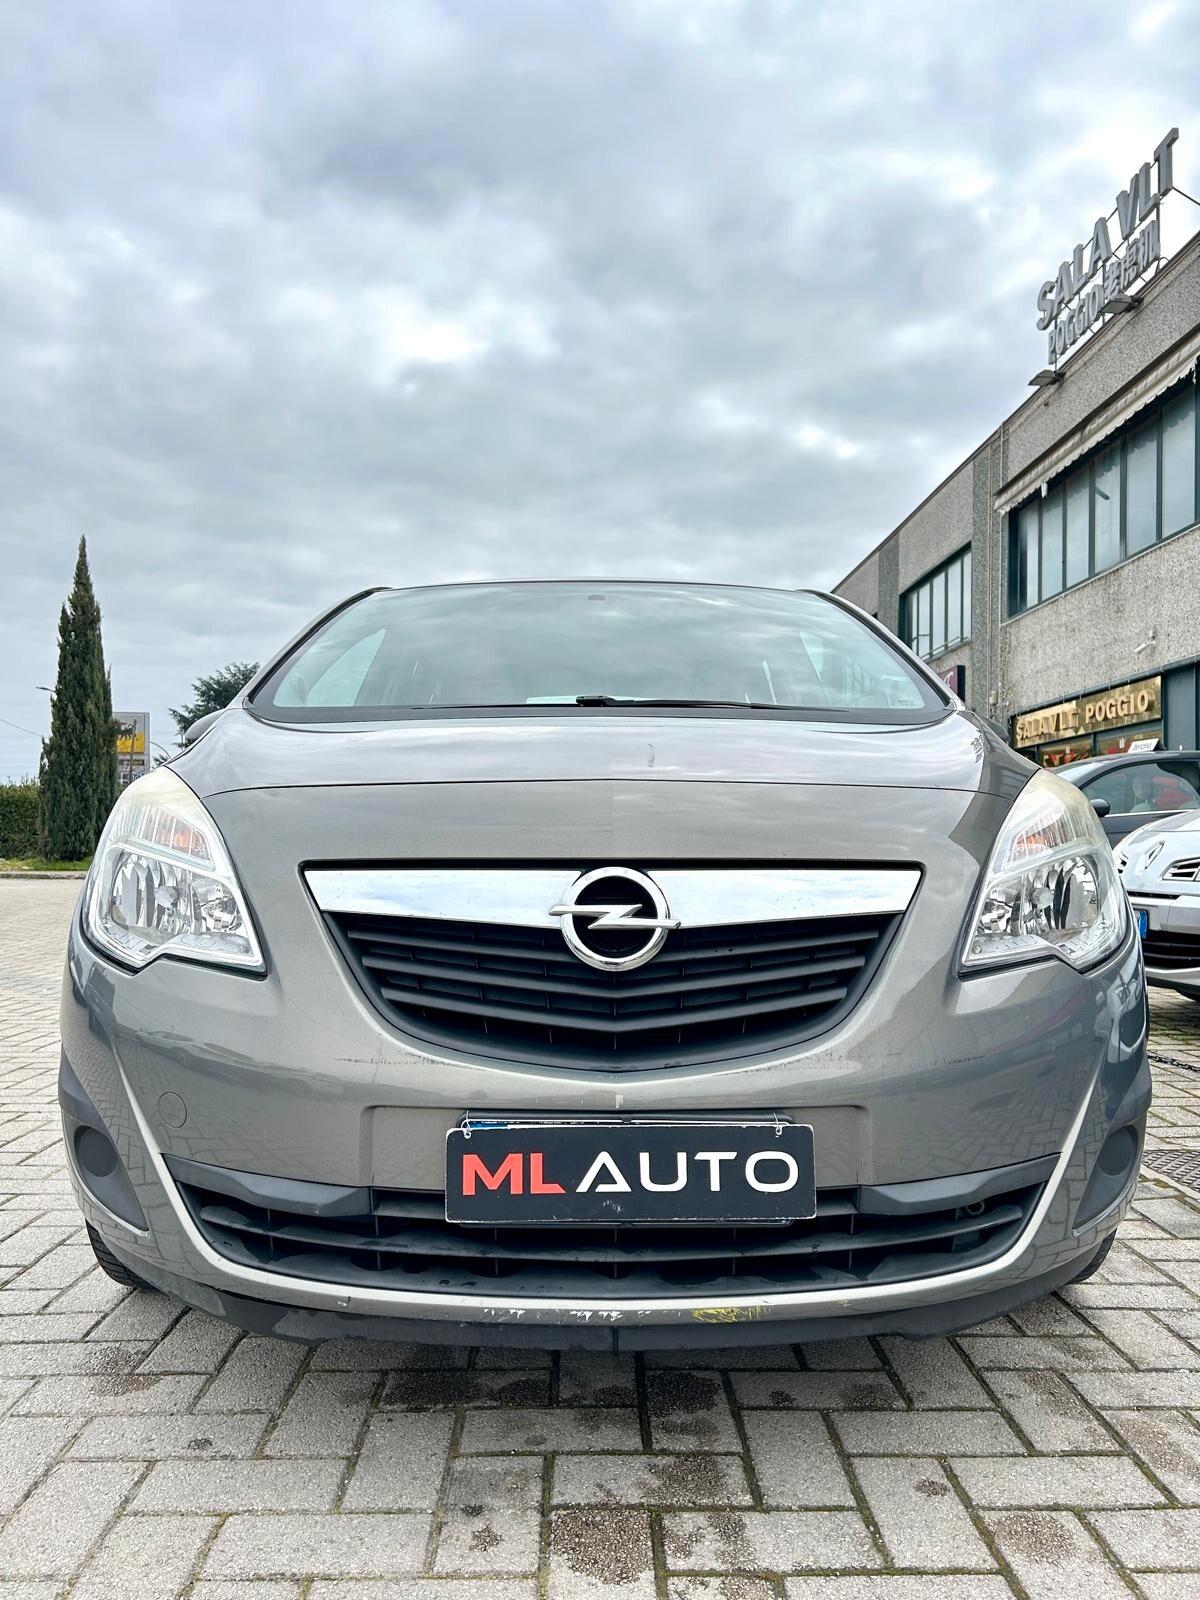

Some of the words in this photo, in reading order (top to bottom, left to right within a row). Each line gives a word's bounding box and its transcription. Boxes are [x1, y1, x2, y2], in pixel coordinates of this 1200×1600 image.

[1037, 216, 1112, 330] SALA
[1116, 127, 1179, 240] VLT
[1048, 284, 1104, 365] POGGIO
[1086, 689, 1149, 724] POGGIO
[462, 1152, 566, 1196] ML
[575, 1151, 799, 1193] AUTO
